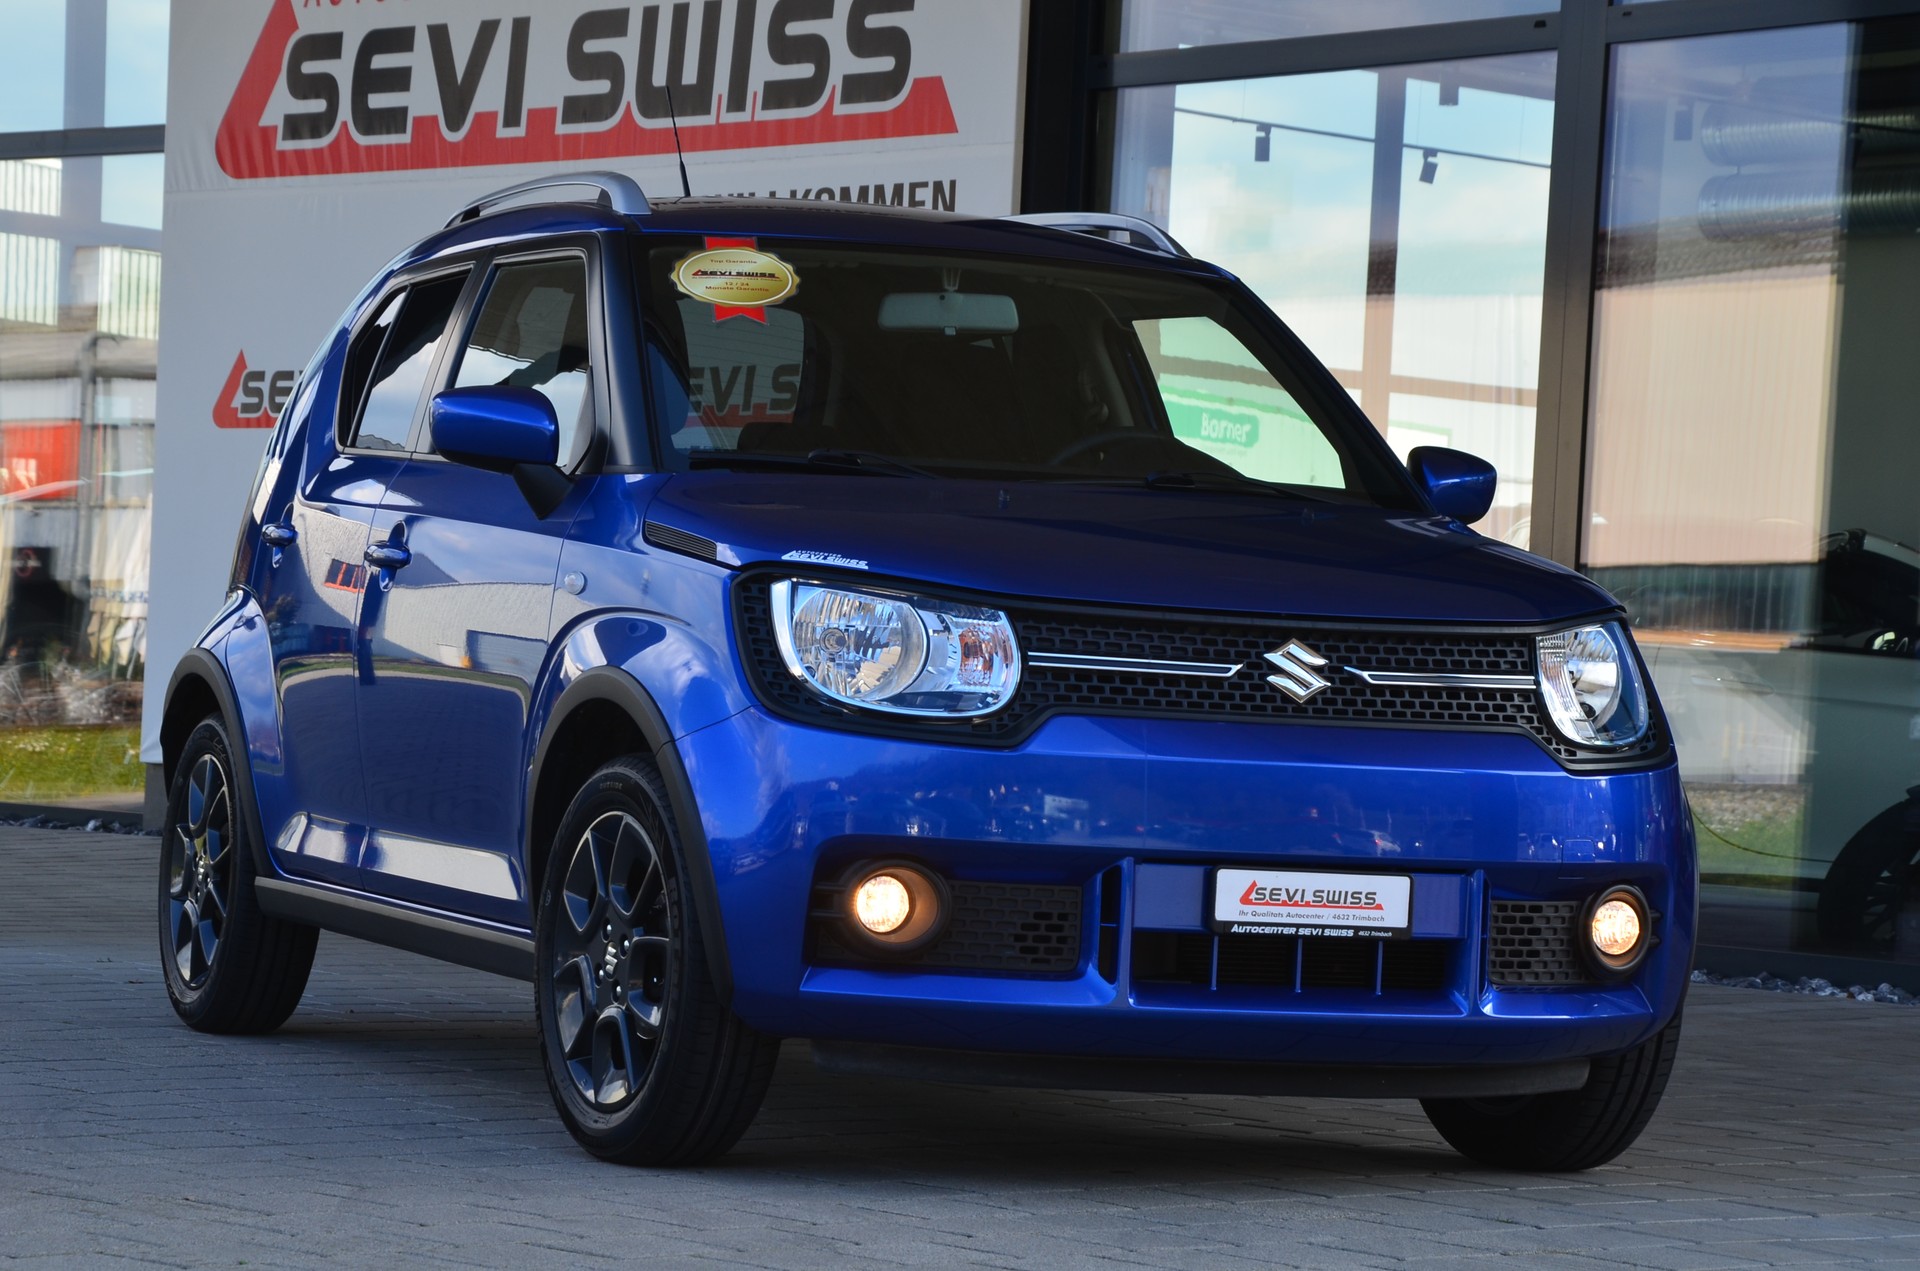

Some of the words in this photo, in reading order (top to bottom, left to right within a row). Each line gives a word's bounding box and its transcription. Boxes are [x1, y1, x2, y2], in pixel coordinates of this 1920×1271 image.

[282, 15, 531, 141] SEVI
[561, 0, 915, 126] SWISS
[1254, 886, 1306, 904] SEVI
[1312, 889, 1377, 906] SWISS
[1285, 911, 1325, 920] Autocenter
[1332, 913, 1350, 921] 4632
[1352, 914, 1385, 922] Trimbach
[1297, 927, 1323, 936] SEVI
[1323, 928, 1355, 937] SWISS
